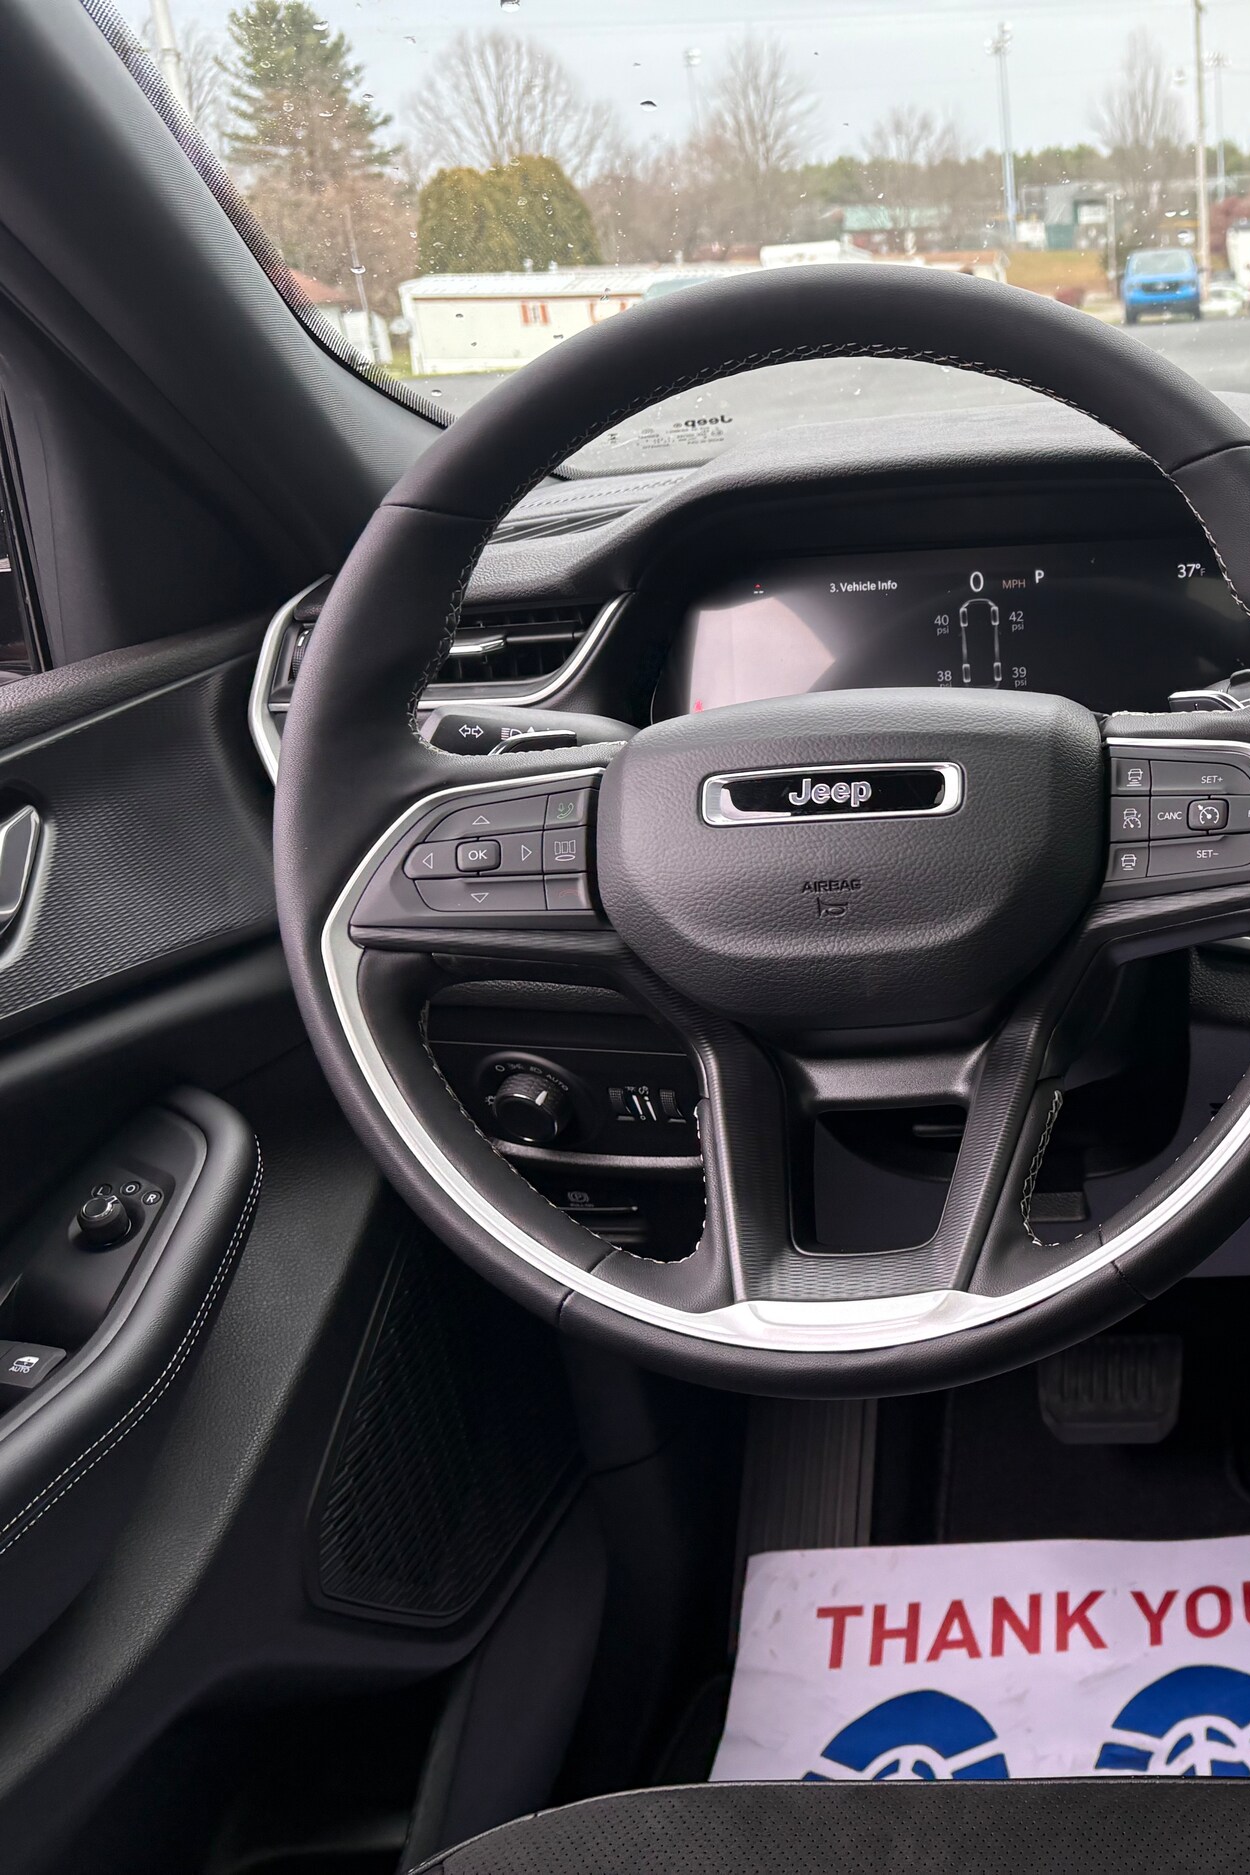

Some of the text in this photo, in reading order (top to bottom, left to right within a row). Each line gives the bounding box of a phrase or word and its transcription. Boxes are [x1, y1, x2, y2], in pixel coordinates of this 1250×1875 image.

[969, 571, 1026, 592] 0 MPH
[1034, 569, 1045, 584] P
[829, 580, 898, 593] 3. Vehicle Info
[934, 614, 949, 626] 40
[1008, 610, 1024, 622] 42
[936, 626, 949, 636] psi
[1011, 622, 1024, 632] psi
[936, 670, 952, 682] 38
[1012, 666, 1027, 678] 39
[1014, 679, 1027, 688] psi
[1201, 775, 1224, 784] SET+
[788, 778, 872, 807] Jeep
[1157, 811, 1183, 821] CANC
[468, 849, 488, 861] OK
[801, 878, 862, 894] AIRBAG
[545, 1073, 569, 1091] AUTO
[146, 1193, 157, 1203] R
[8, 1365, 31, 1374] AUTO
[817, 1589, 1108, 1671] THANK
